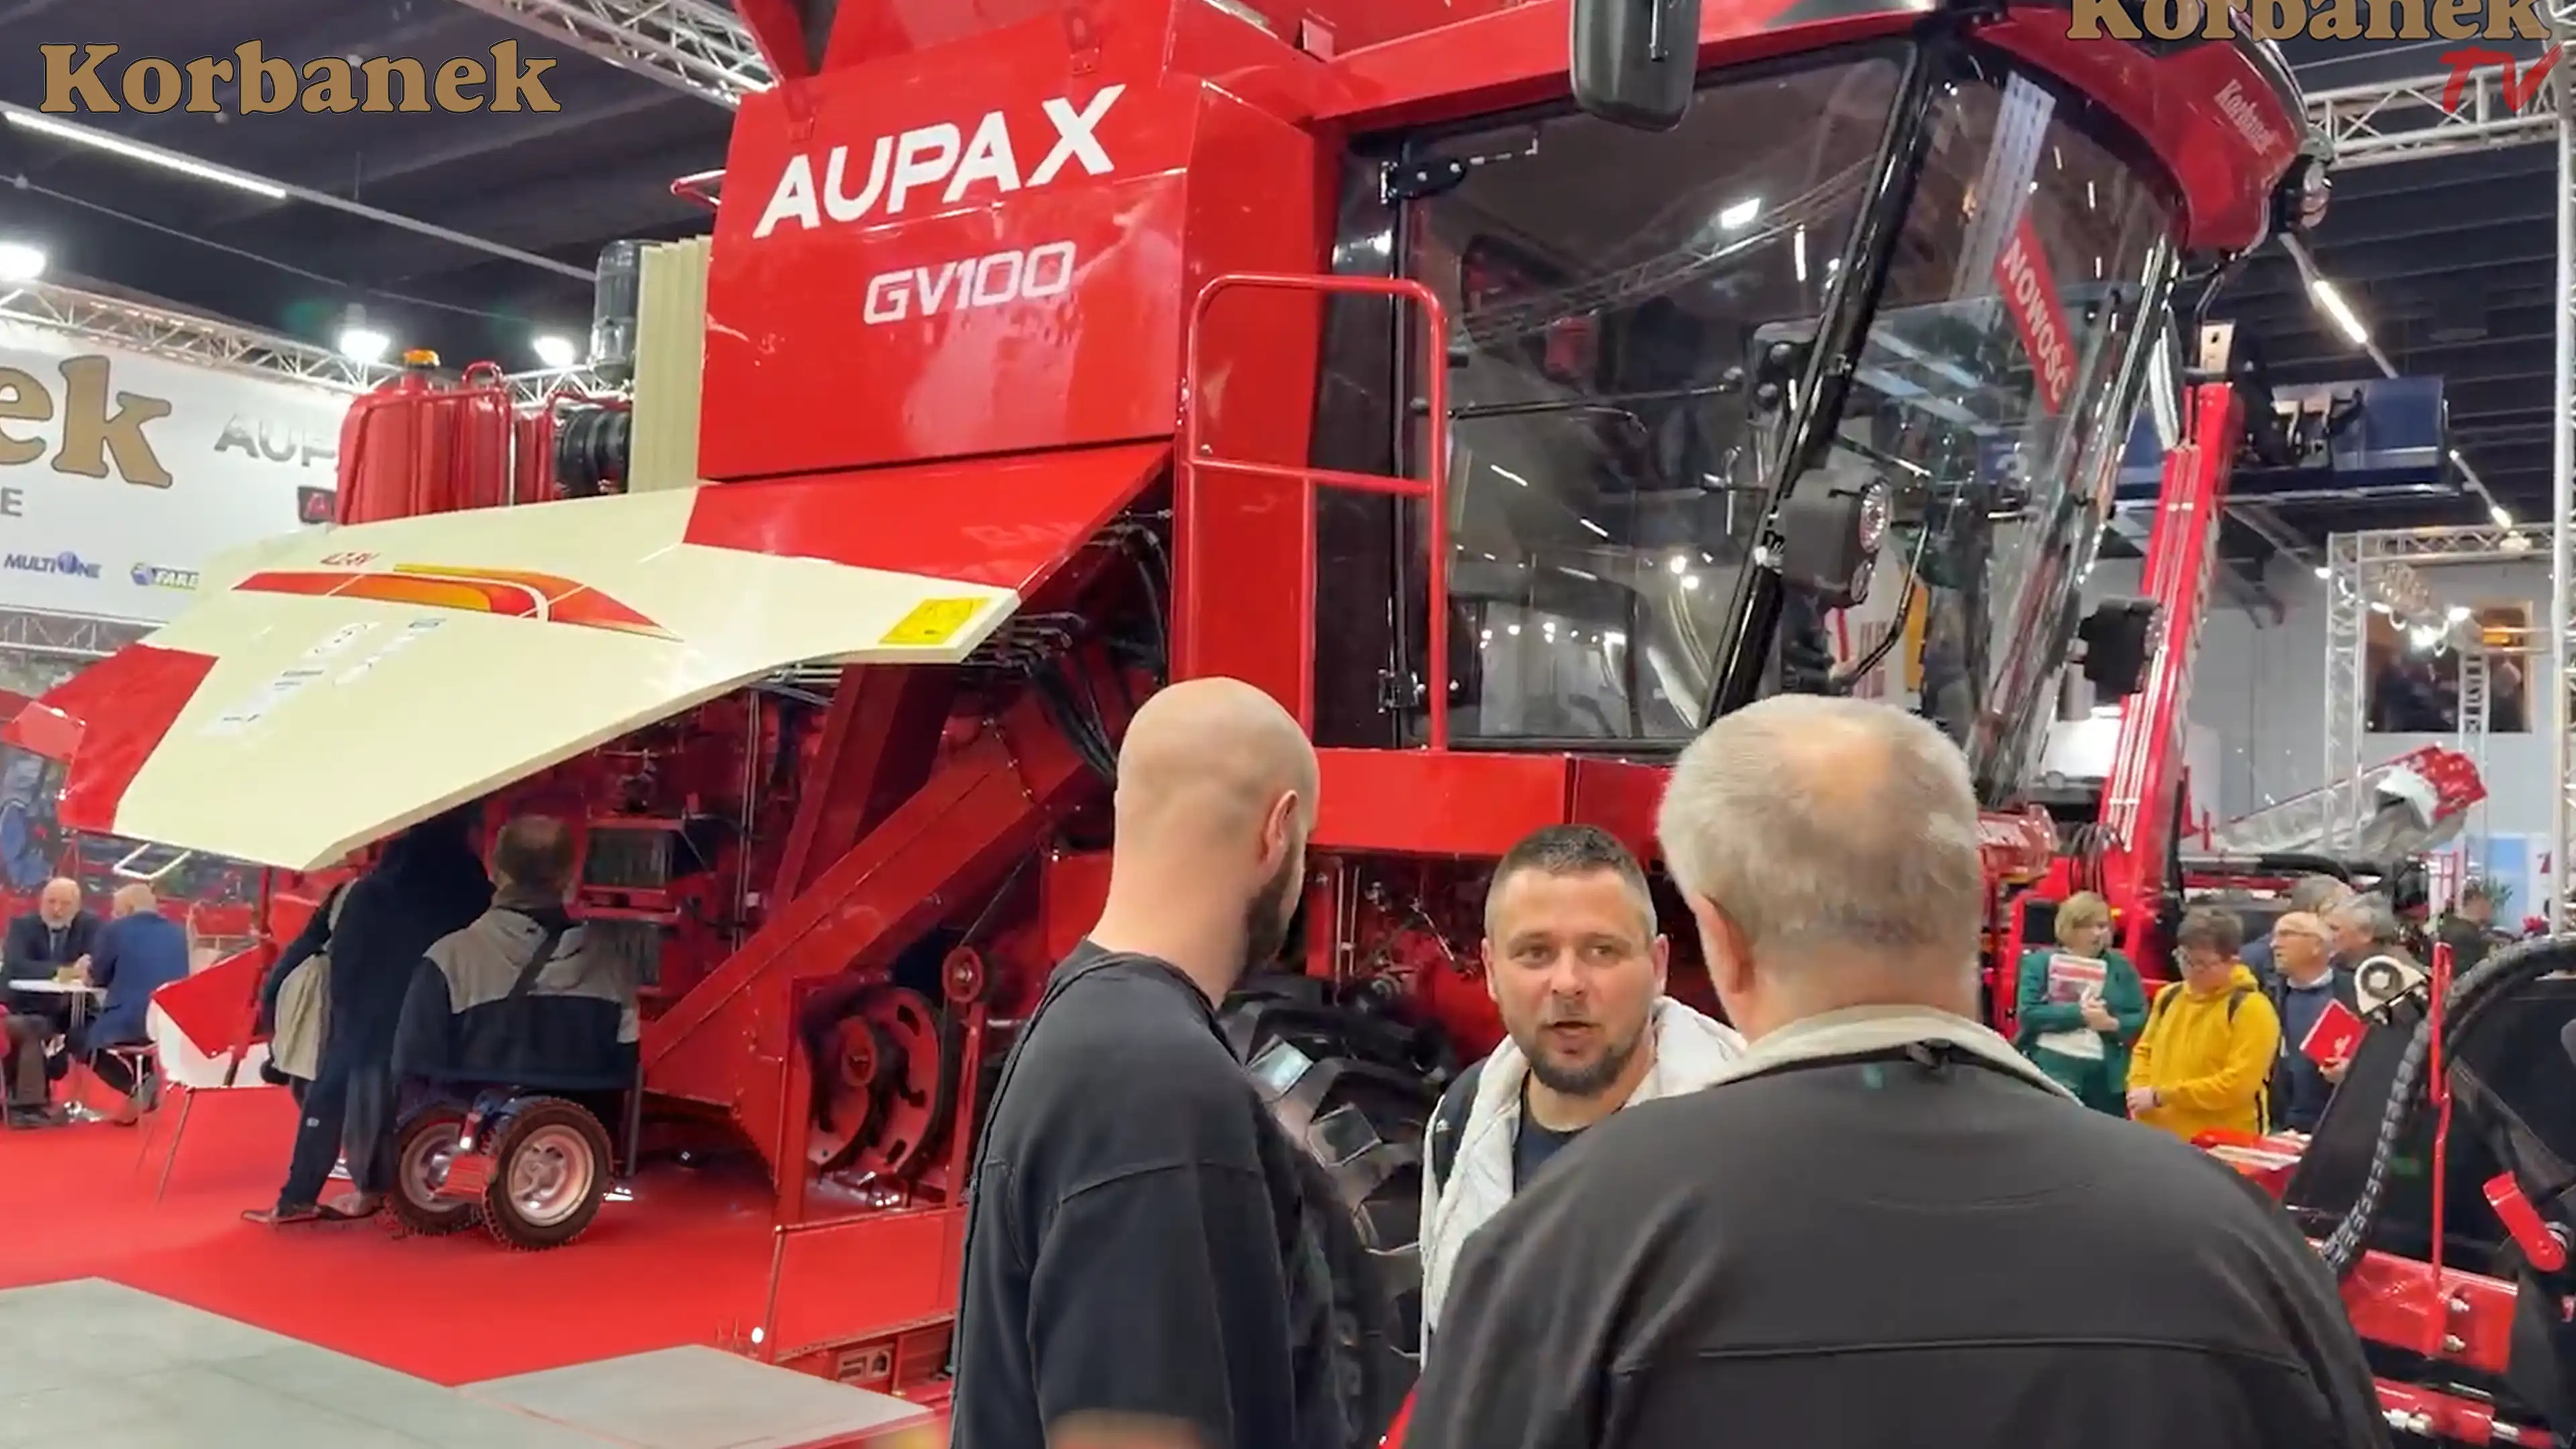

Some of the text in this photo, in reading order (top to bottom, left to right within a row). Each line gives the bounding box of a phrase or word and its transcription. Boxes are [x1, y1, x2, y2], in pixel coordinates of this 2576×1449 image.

[752, 84, 1126, 239] AUPAX
[2214, 78, 2284, 156] Korbanek
[863, 240, 1077, 325] GV100
[2002, 237, 2070, 402] NOWOŚĆ
